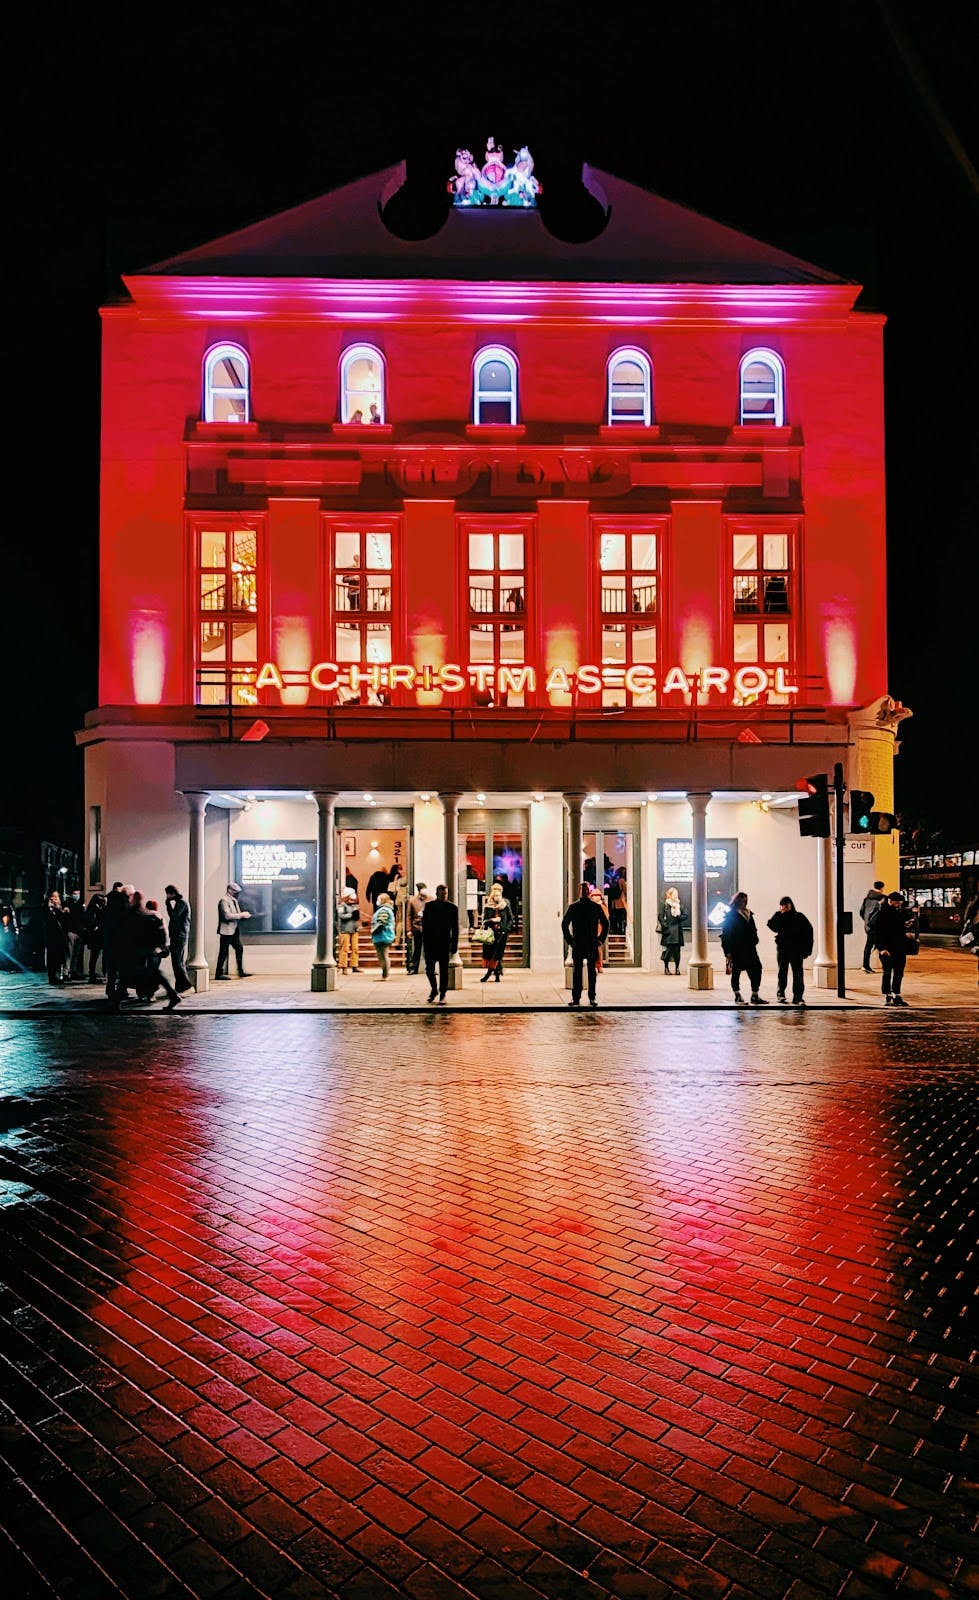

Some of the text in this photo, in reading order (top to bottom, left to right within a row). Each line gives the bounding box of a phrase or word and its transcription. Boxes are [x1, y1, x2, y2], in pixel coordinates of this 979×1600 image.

[256, 662, 799, 695] A CHRISTMAS CAROL
